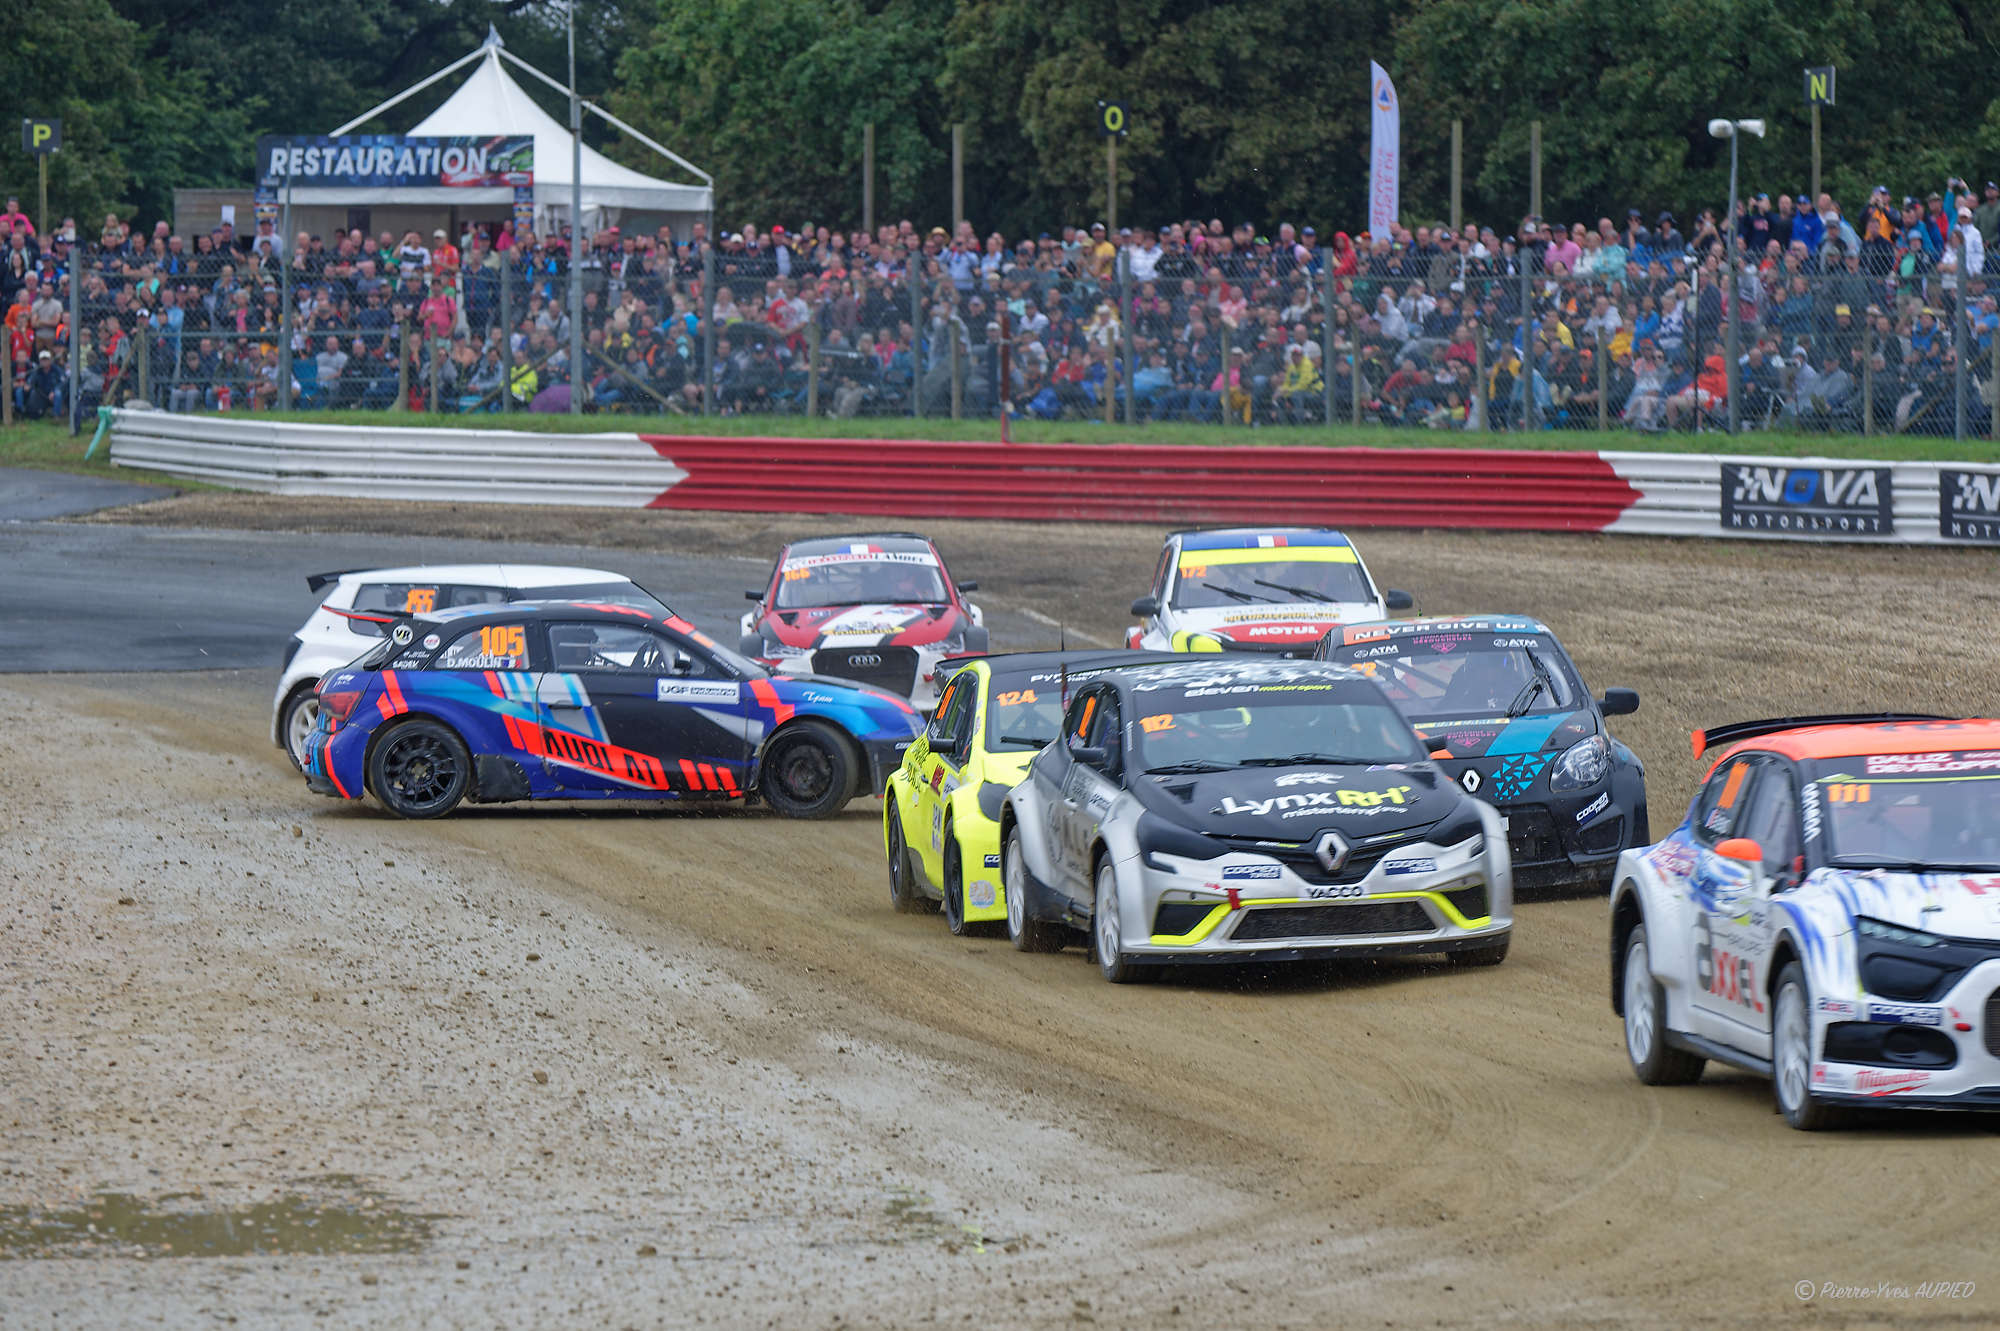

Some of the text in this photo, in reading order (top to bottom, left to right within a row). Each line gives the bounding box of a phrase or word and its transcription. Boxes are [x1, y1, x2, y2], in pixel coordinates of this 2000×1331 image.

[1810, 73, 1827, 100] N
[33, 124, 52, 147] P
[269, 147, 487, 176] RESTAURATION
[1734, 467, 1880, 505] NOVA
[1732, 513, 1880, 532] MOTORSPORT
[1249, 625, 1319, 637] MOTUL
[1353, 624, 1430, 641] NEVER
[1437, 622, 1489, 630] GIVE
[480, 626, 523, 657] 105
[1369, 645, 1400, 657] ATM
[1508, 638, 1539, 648] ATM
[996, 689, 1038, 707] 124
[543, 726, 614, 772] AUDI
[1827, 783, 1871, 803] 111
[1577, 791, 1608, 821] COOPER
[1224, 865, 1282, 875] COOPER
[1384, 858, 1435, 869] COOPER
[1307, 886, 1364, 899] YACCO
